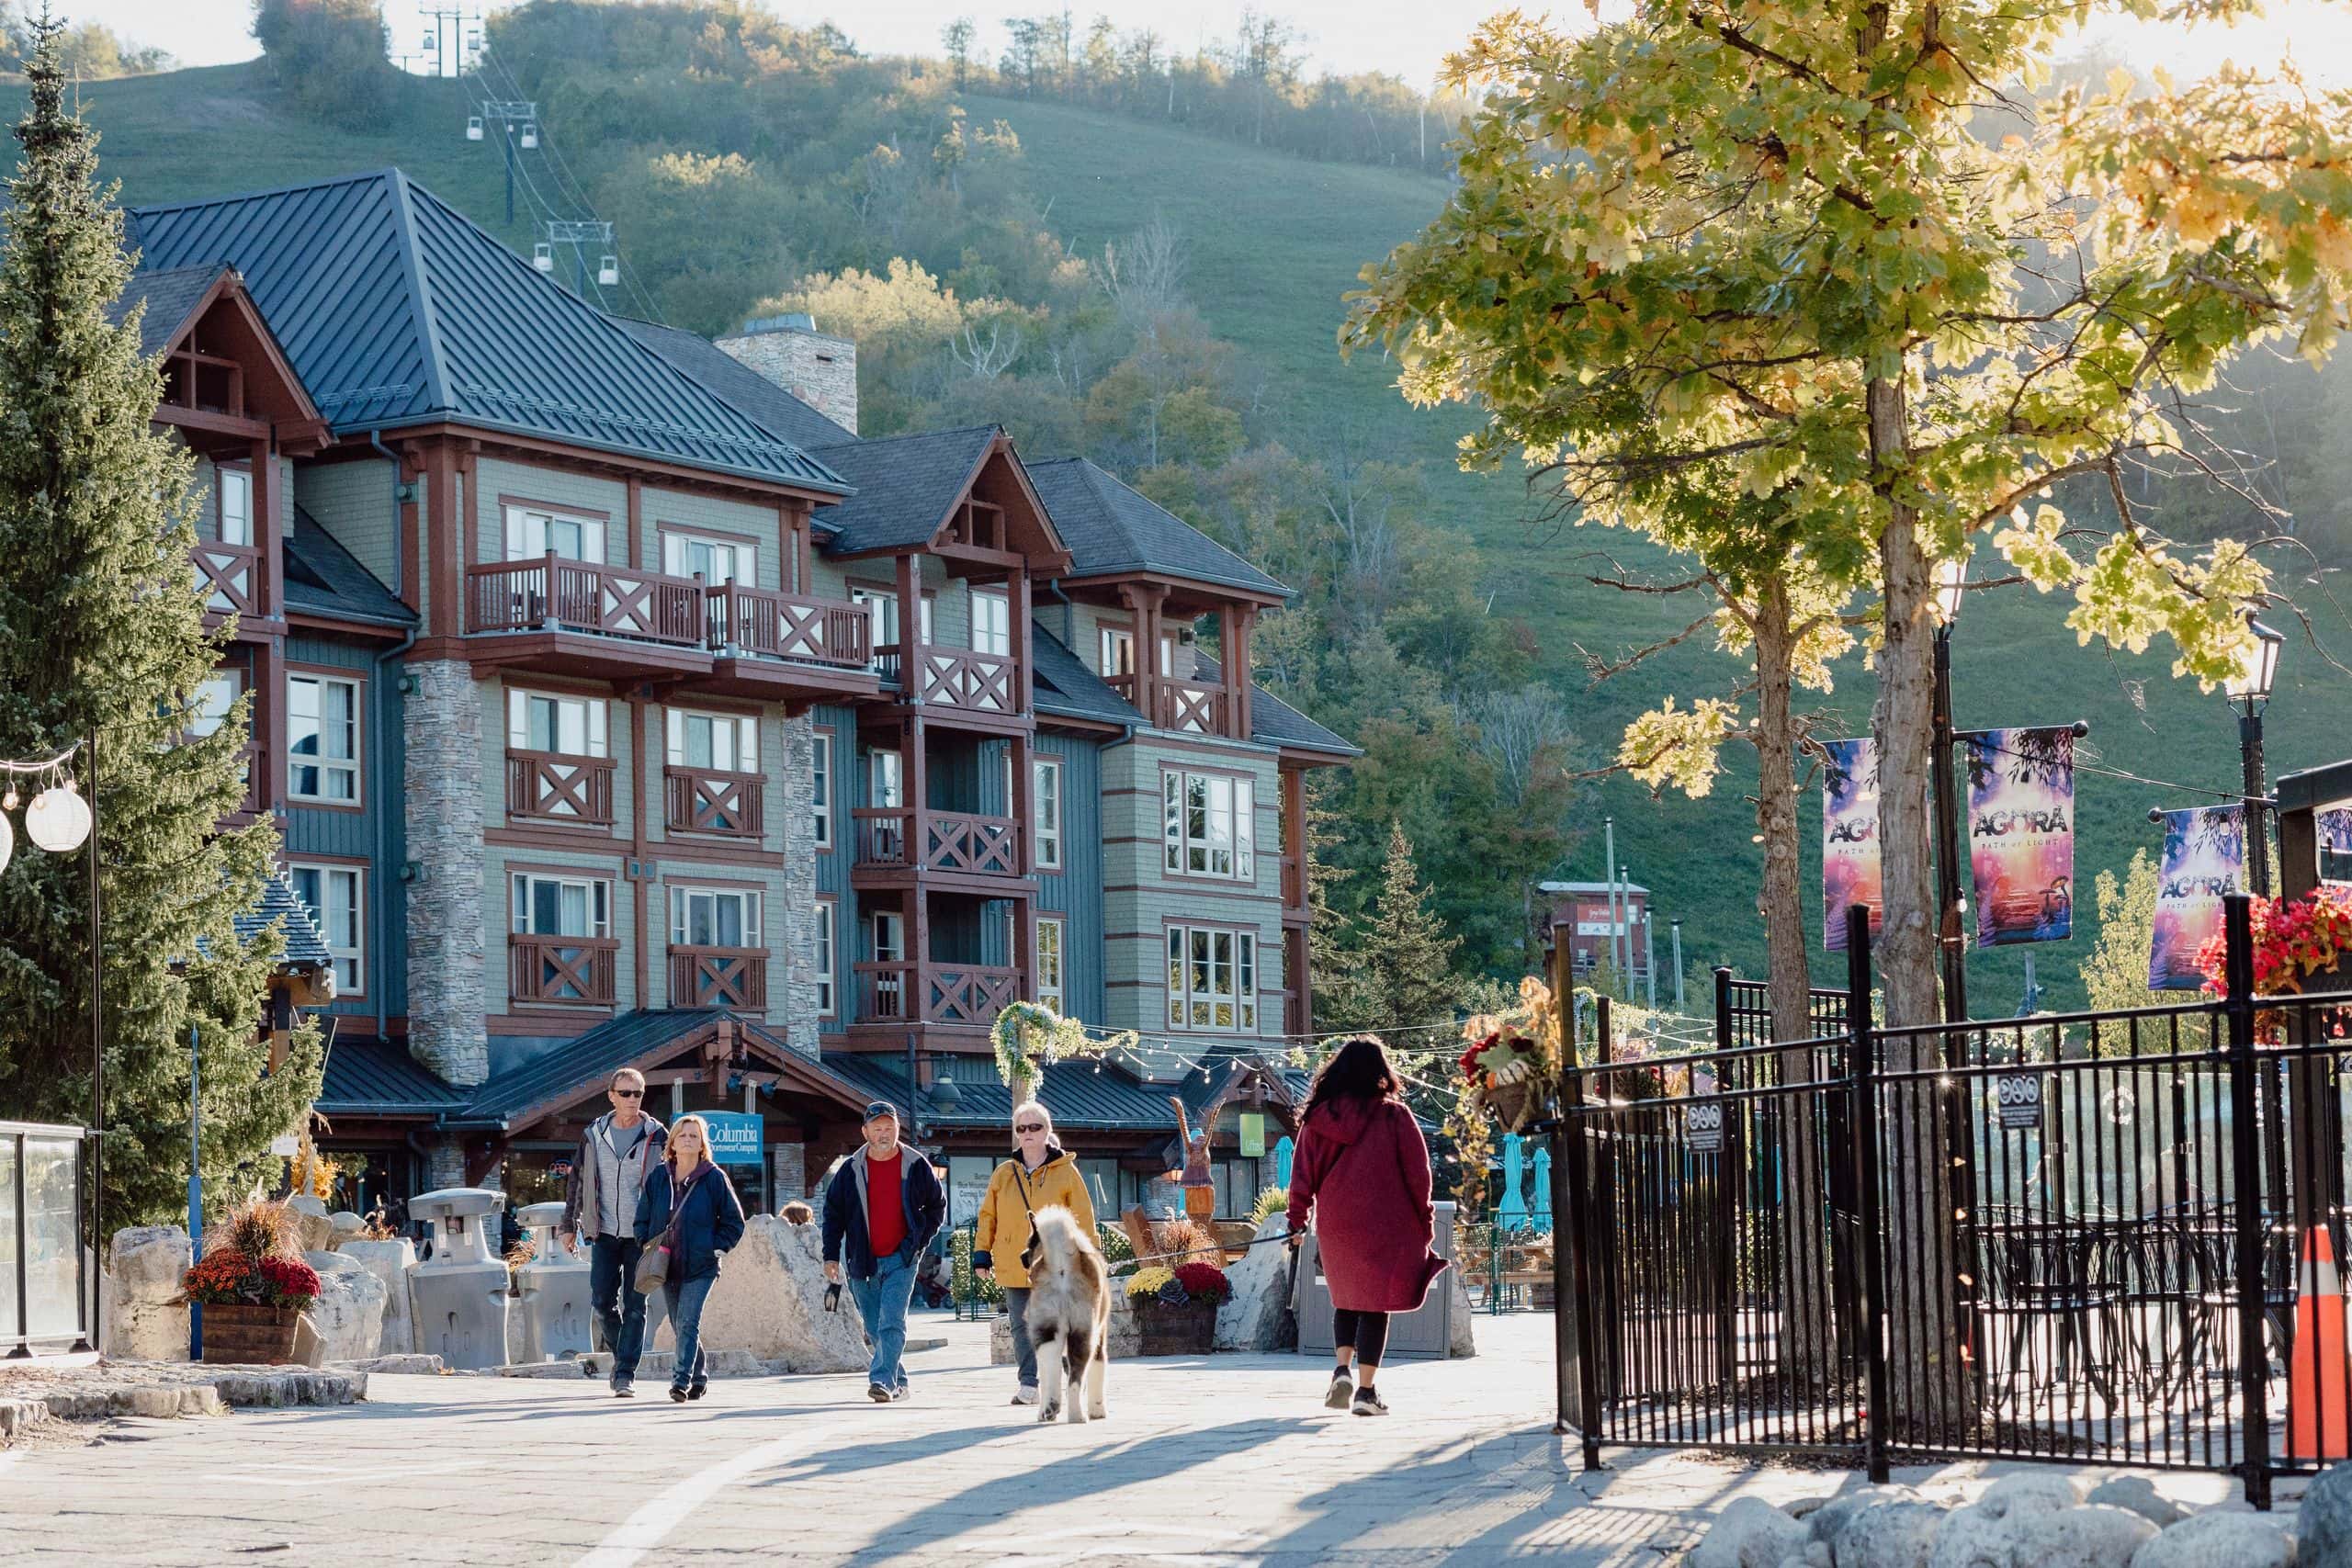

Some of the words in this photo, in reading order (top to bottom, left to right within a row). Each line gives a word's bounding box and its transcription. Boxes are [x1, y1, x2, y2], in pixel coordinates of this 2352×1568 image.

[1973, 806, 2068, 838] AGORA
[1982, 840, 2007, 849] PATH
[2027, 837, 2059, 847] LIGHT
[2161, 873, 2236, 899] AGORA
[707, 1122, 758, 1143] Columbia
[736, 1143, 757, 1154] Company
